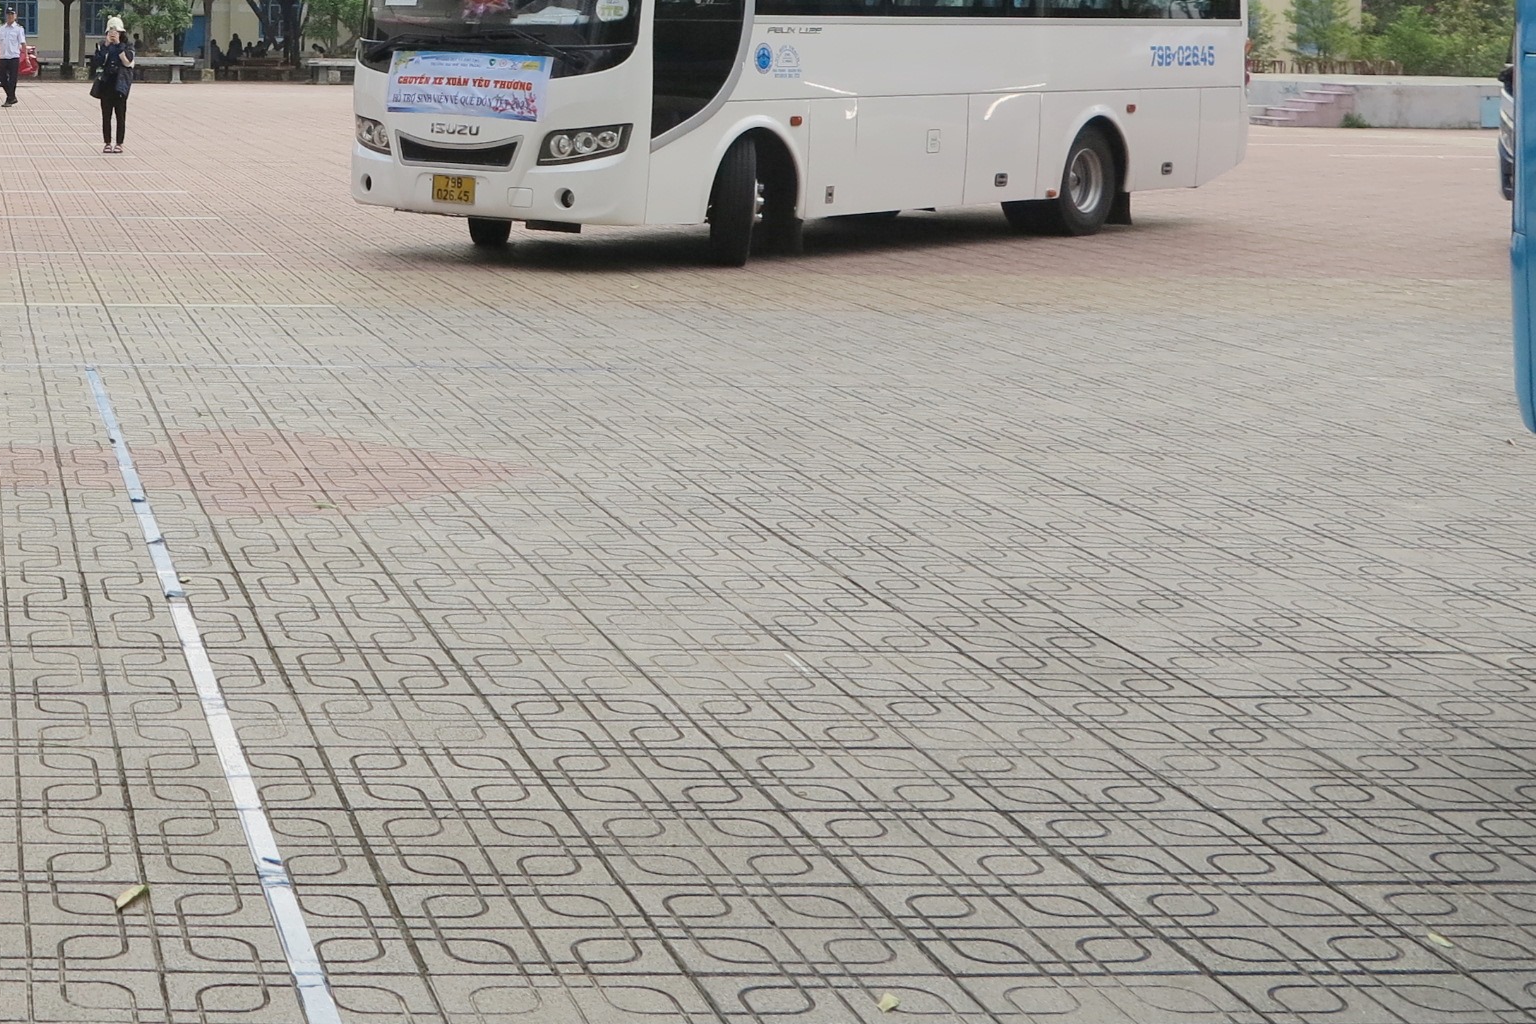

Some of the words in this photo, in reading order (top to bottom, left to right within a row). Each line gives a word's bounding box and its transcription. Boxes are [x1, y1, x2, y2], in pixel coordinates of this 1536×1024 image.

[398, 73, 431, 85] CHUYẾN
[432, 76, 444, 85] XE
[430, 122, 480, 136] ISUZU
[444, 176, 463, 189] 79B
[436, 188, 470, 202] 026.45
